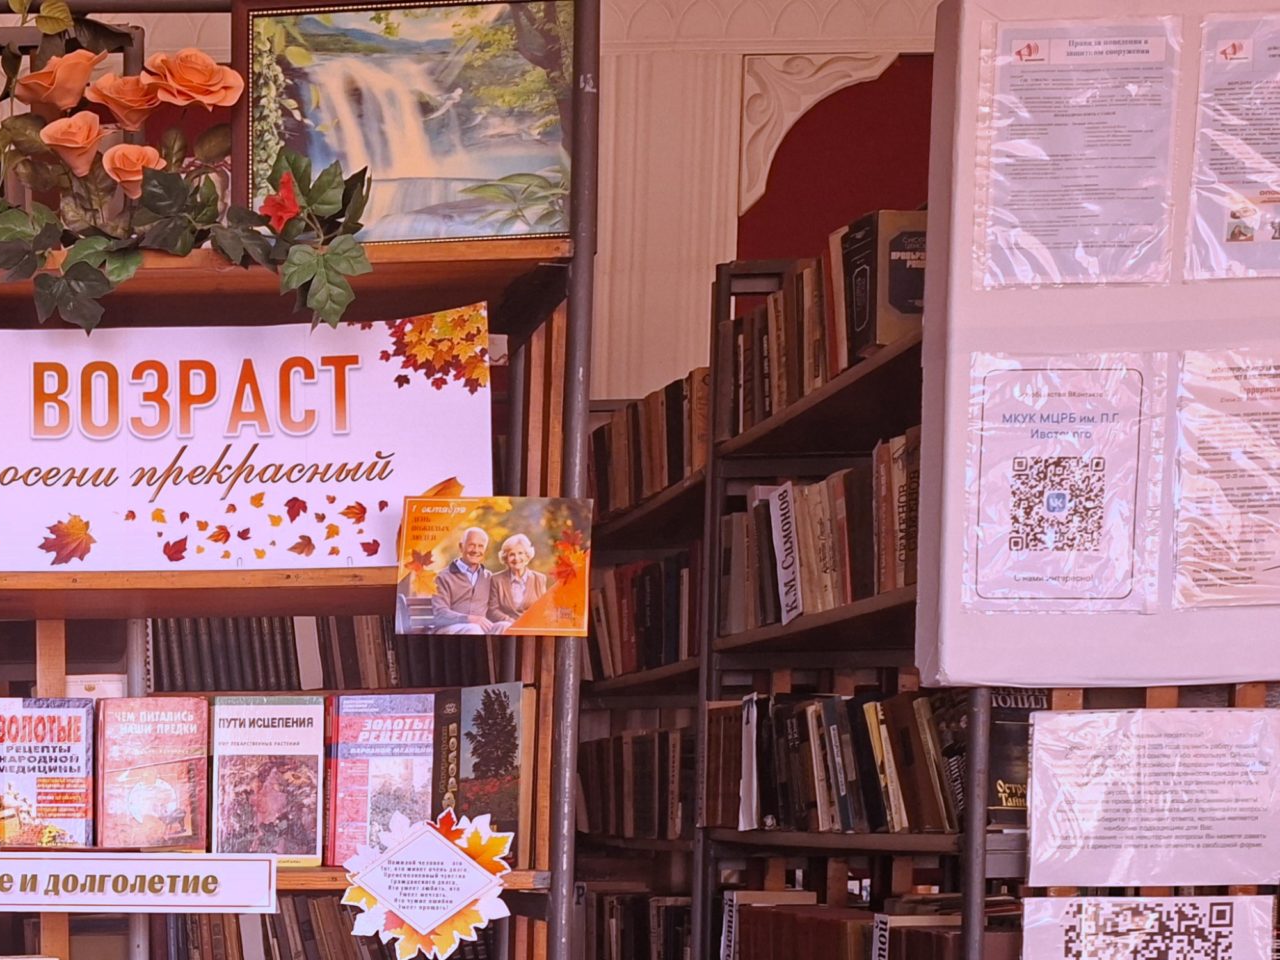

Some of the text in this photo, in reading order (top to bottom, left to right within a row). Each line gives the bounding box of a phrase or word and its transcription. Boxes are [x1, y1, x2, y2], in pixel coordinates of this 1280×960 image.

[32, 354, 360, 439] ВОЗРАСТ
[1002, 413, 1036, 424] МКУК
[1040, 412, 1077, 425] МЦРБ
[130, 442, 395, 503] прекрасный
[114, 711, 194, 722] ЧЕМ ПИТАЛИСЬ
[156, 723, 198, 735] ПРЕДКИ
[218, 717, 314, 729] ПУТИ ИСЦЕЛЕНИЯ
[6, 745, 71, 755] РЕЦЕПТЫ
[19, 873, 39, 892] и
[43, 873, 219, 897] долголетие
